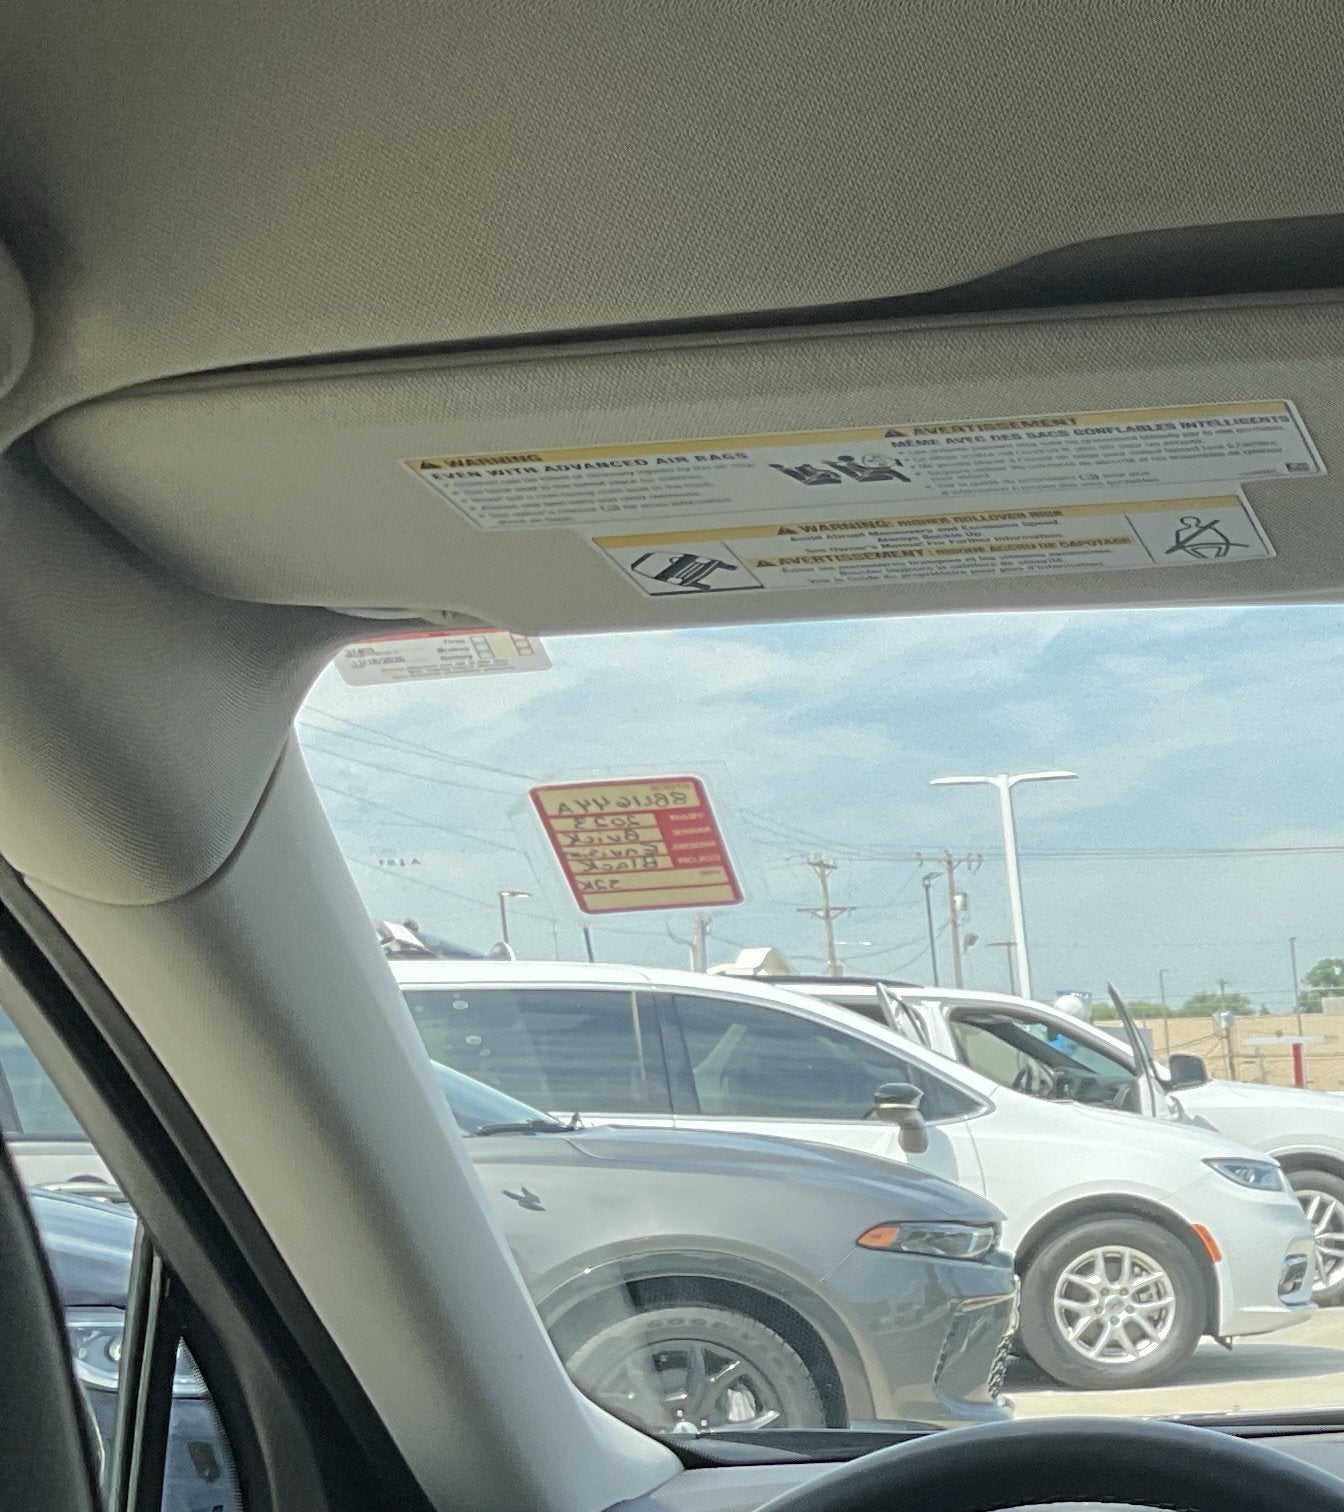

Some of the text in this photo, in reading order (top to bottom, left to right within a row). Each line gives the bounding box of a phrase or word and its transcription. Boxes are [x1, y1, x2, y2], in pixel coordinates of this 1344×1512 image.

[444, 454, 542, 467] WARNING
[488, 467, 539, 477] WITH
[544, 459, 649, 472] ADVANCED
